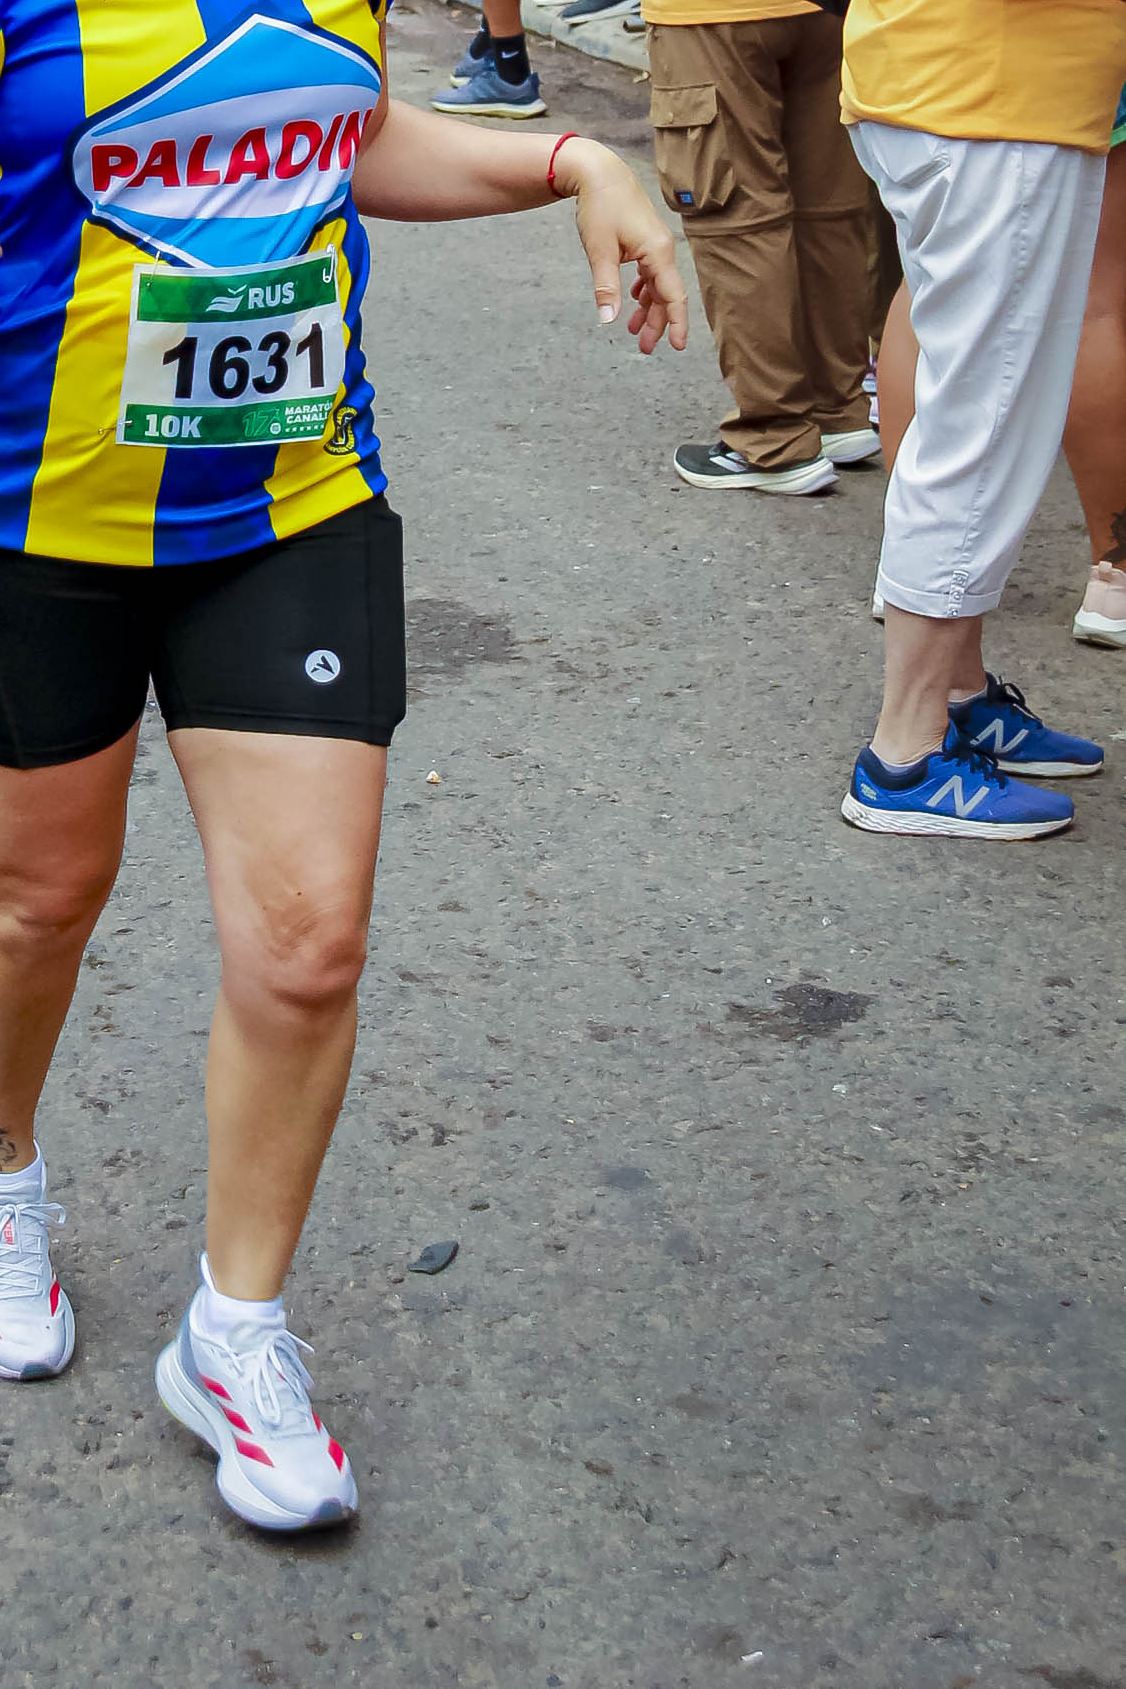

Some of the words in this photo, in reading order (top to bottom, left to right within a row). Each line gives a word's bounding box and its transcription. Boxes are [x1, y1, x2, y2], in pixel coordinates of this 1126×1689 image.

[91, 109, 373, 192] PALADIN
[248, 282, 295, 310] RUS
[162, 322, 325, 400] 1631
[144, 413, 203, 439] 10K
